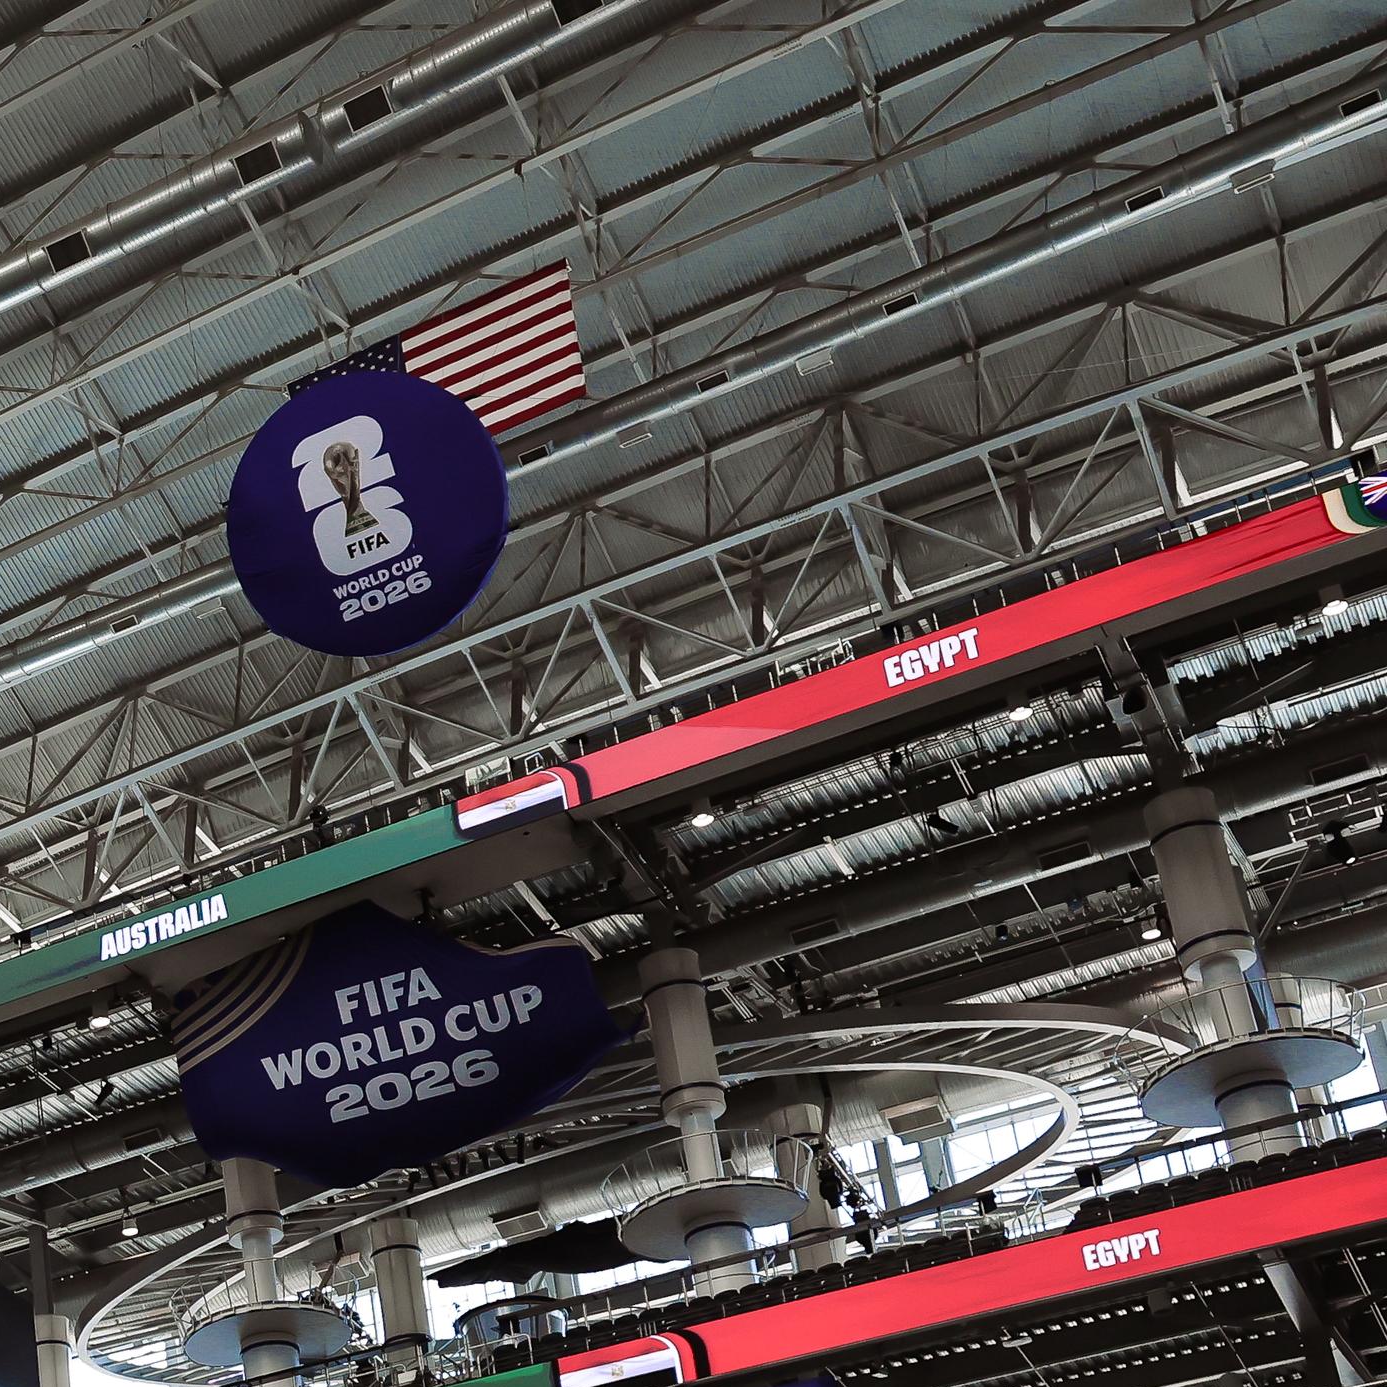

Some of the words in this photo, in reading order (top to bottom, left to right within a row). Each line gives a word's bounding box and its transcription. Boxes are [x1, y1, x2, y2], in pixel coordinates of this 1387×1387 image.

[346, 531, 391, 560] FIFA
[333, 569, 390, 600] WORLD
[391, 554, 424, 577] CUP
[339, 570, 433, 622] 2026
[882, 628, 980, 688] EGYPT
[100, 894, 227, 961] AUSTRALIA
[335, 967, 442, 1025] FIFA
[260, 1012, 436, 1090] WORLD
[444, 984, 543, 1041] CUP
[326, 1050, 499, 1124] 2026
[1082, 1228, 1160, 1271] EGYPT
